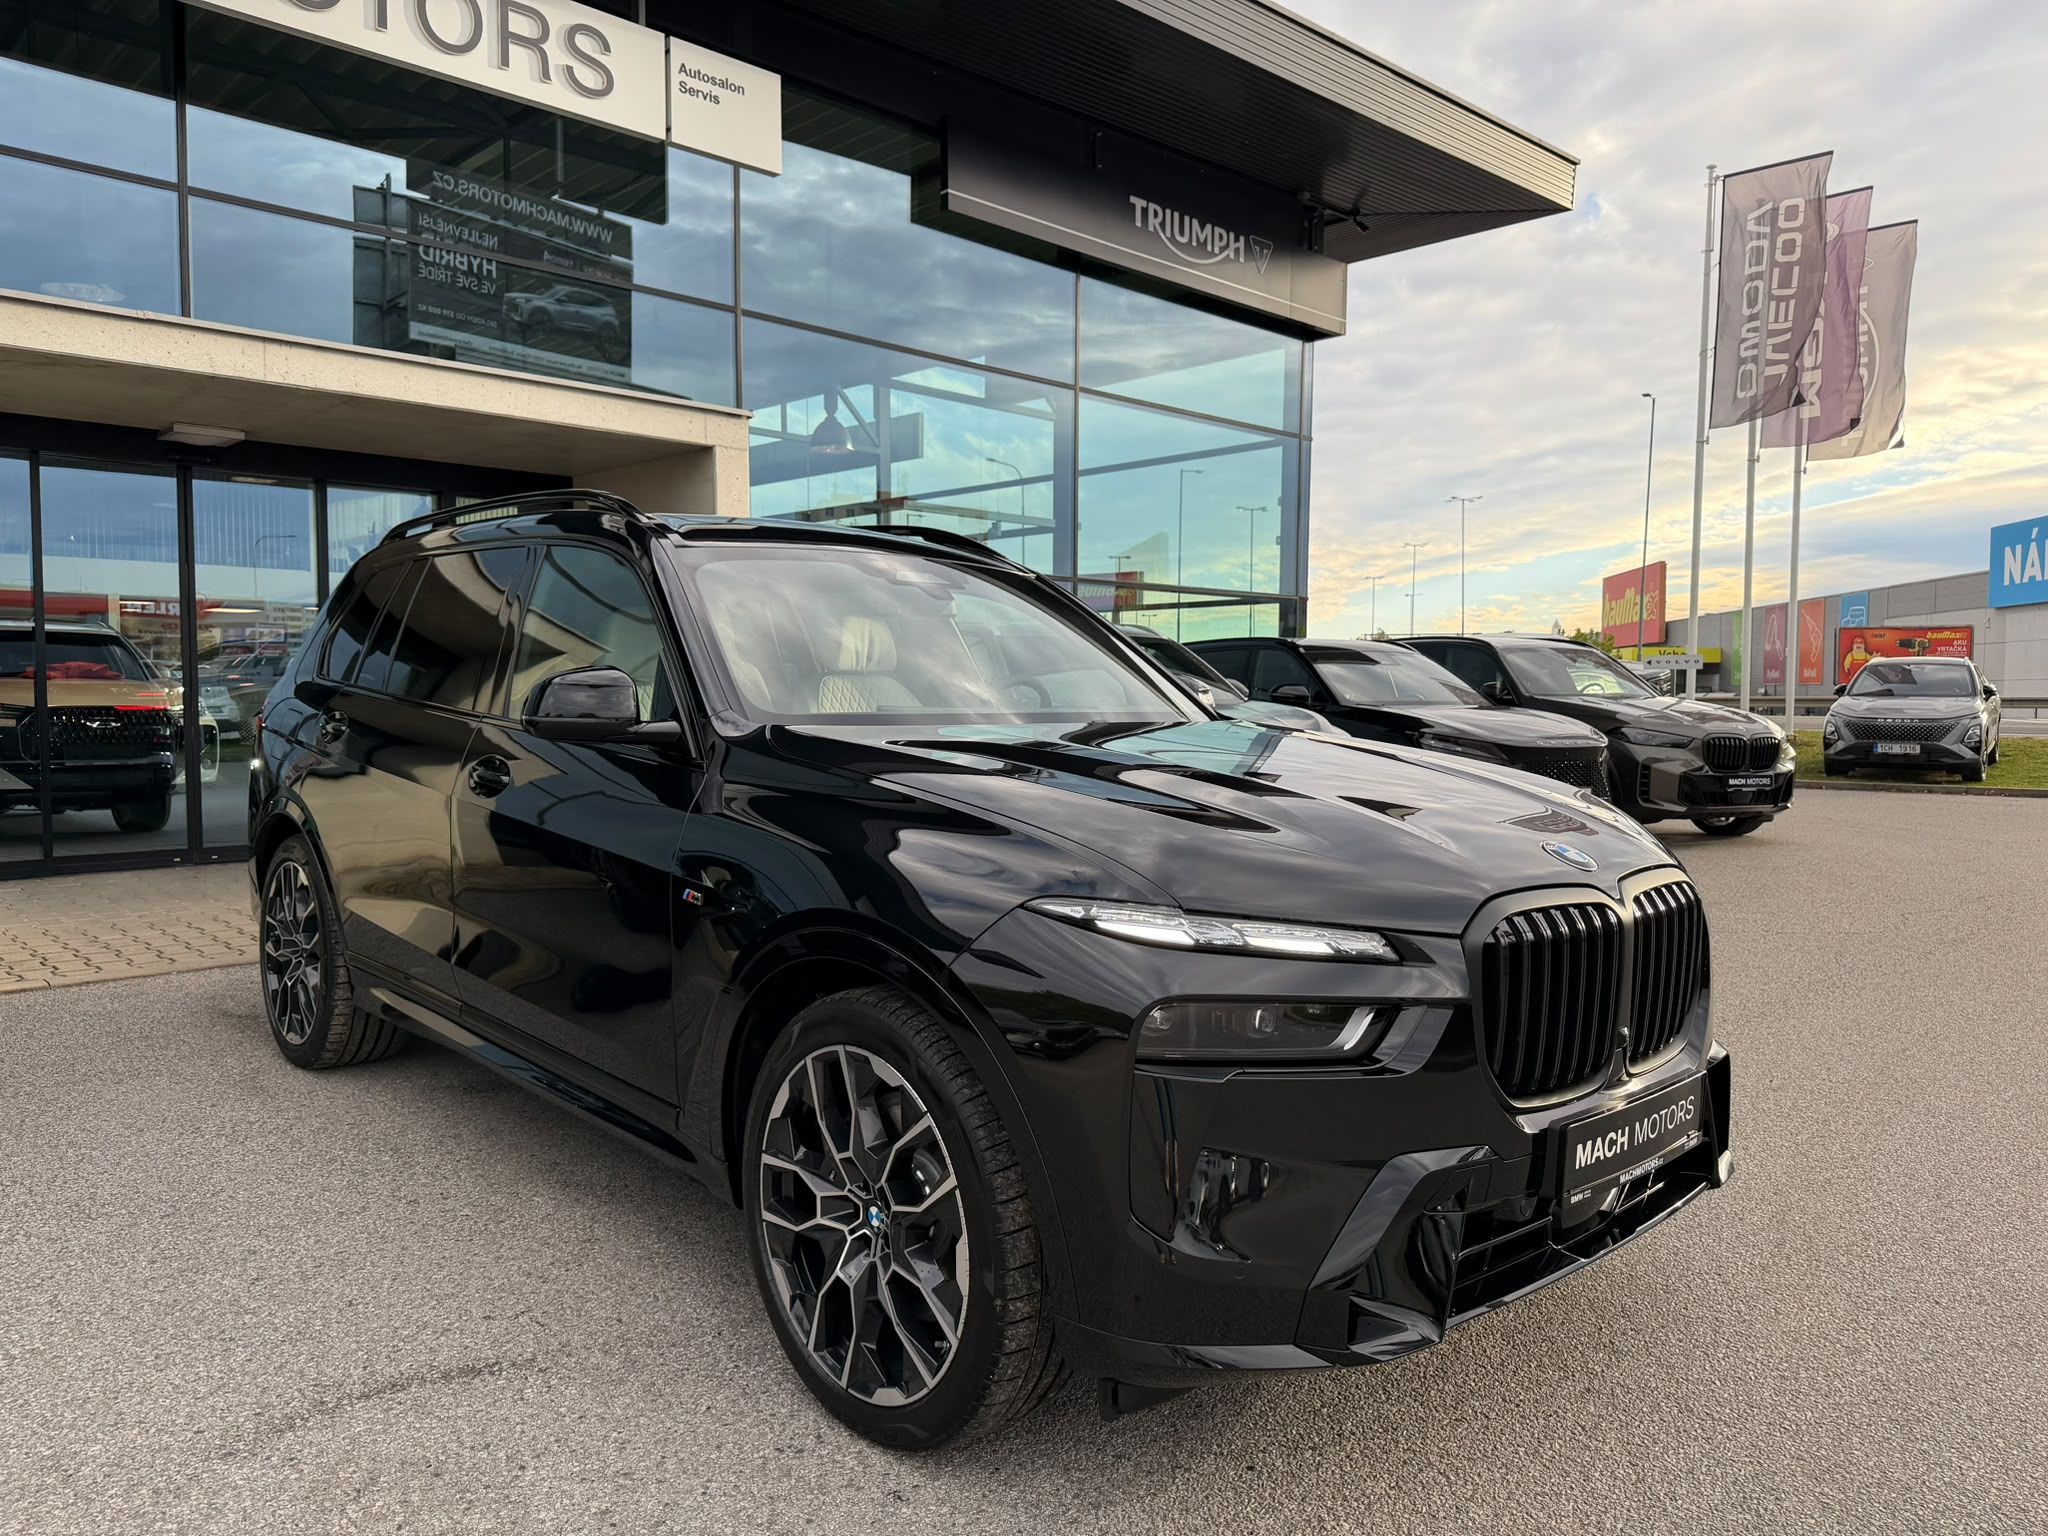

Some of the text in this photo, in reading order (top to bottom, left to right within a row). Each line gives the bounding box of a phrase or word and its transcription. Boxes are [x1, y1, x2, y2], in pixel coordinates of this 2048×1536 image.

[288, 0, 614, 99] ORS
[678, 62, 745, 96] Autosalon
[678, 80, 720, 105] Servis
[1129, 195, 1245, 265] TRIUMPH
[1735, 201, 1773, 399] OMODA
[1764, 197, 1806, 386] JAECOO
[1746, 777, 1771, 785] MOTORS
[1575, 1095, 1695, 1170] MACH MOTORS
